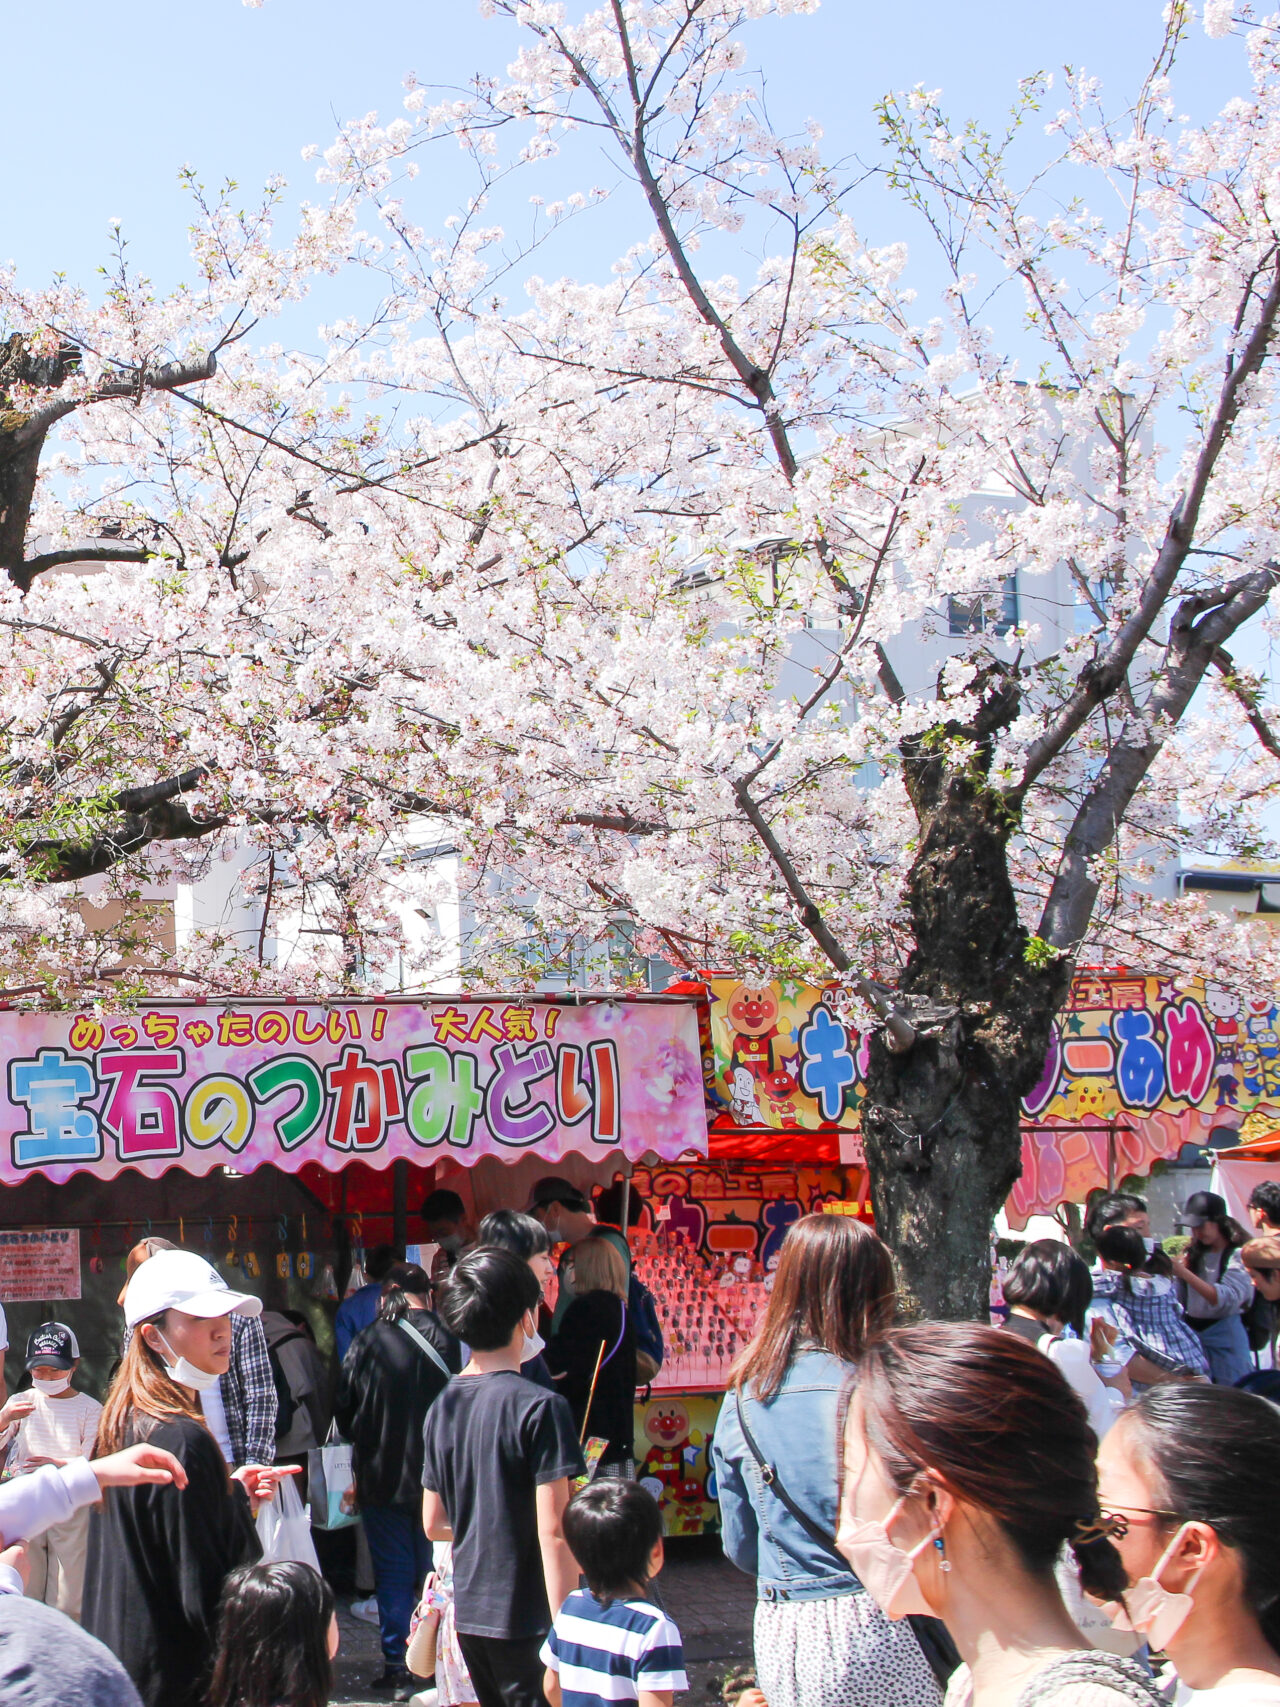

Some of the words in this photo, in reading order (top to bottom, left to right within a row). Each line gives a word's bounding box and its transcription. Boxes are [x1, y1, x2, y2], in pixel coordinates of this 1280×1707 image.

[1056, 979, 1147, 1011] 工房
[68, 1006, 389, 1051] めっちゃたのしい！
[431, 1005, 562, 1044] 大人気！
[8, 1040, 621, 1168] 宝石のつかみどり
